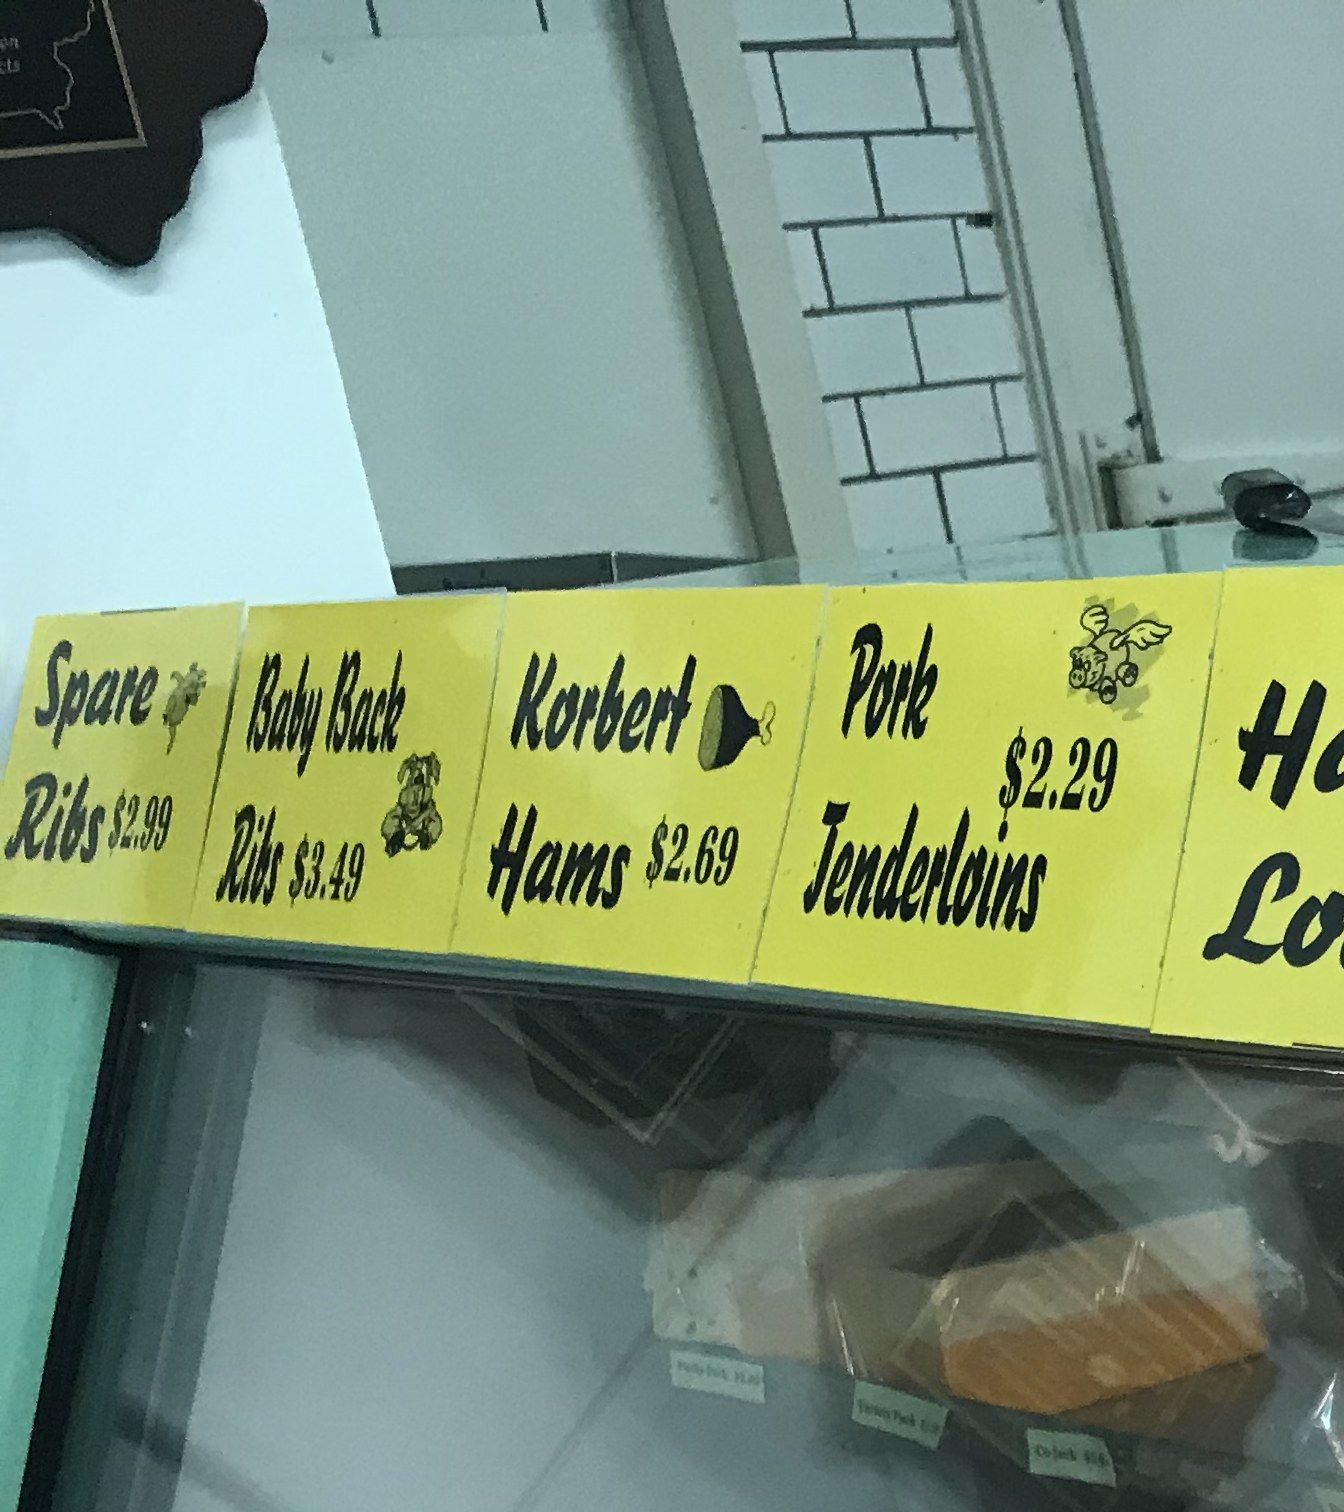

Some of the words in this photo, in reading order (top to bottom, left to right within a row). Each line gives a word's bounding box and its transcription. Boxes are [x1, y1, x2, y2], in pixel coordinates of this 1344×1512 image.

[35, 639, 158, 751] Spare
[246, 652, 323, 776] Baby
[326, 650, 406, 754] Back
[509, 652, 698, 752] Korbert
[841, 622, 939, 741] Pork
[4, 774, 105, 864] Ribs
[107, 791, 173, 853] $2.99
[999, 727, 1117, 817] $2.29
[216, 804, 283, 904] Ribs
[289, 836, 366, 907] $3.49
[487, 802, 630, 916] Hams
[646, 814, 740, 889] $2.69
[802, 802, 1048, 934] Tenderloins
